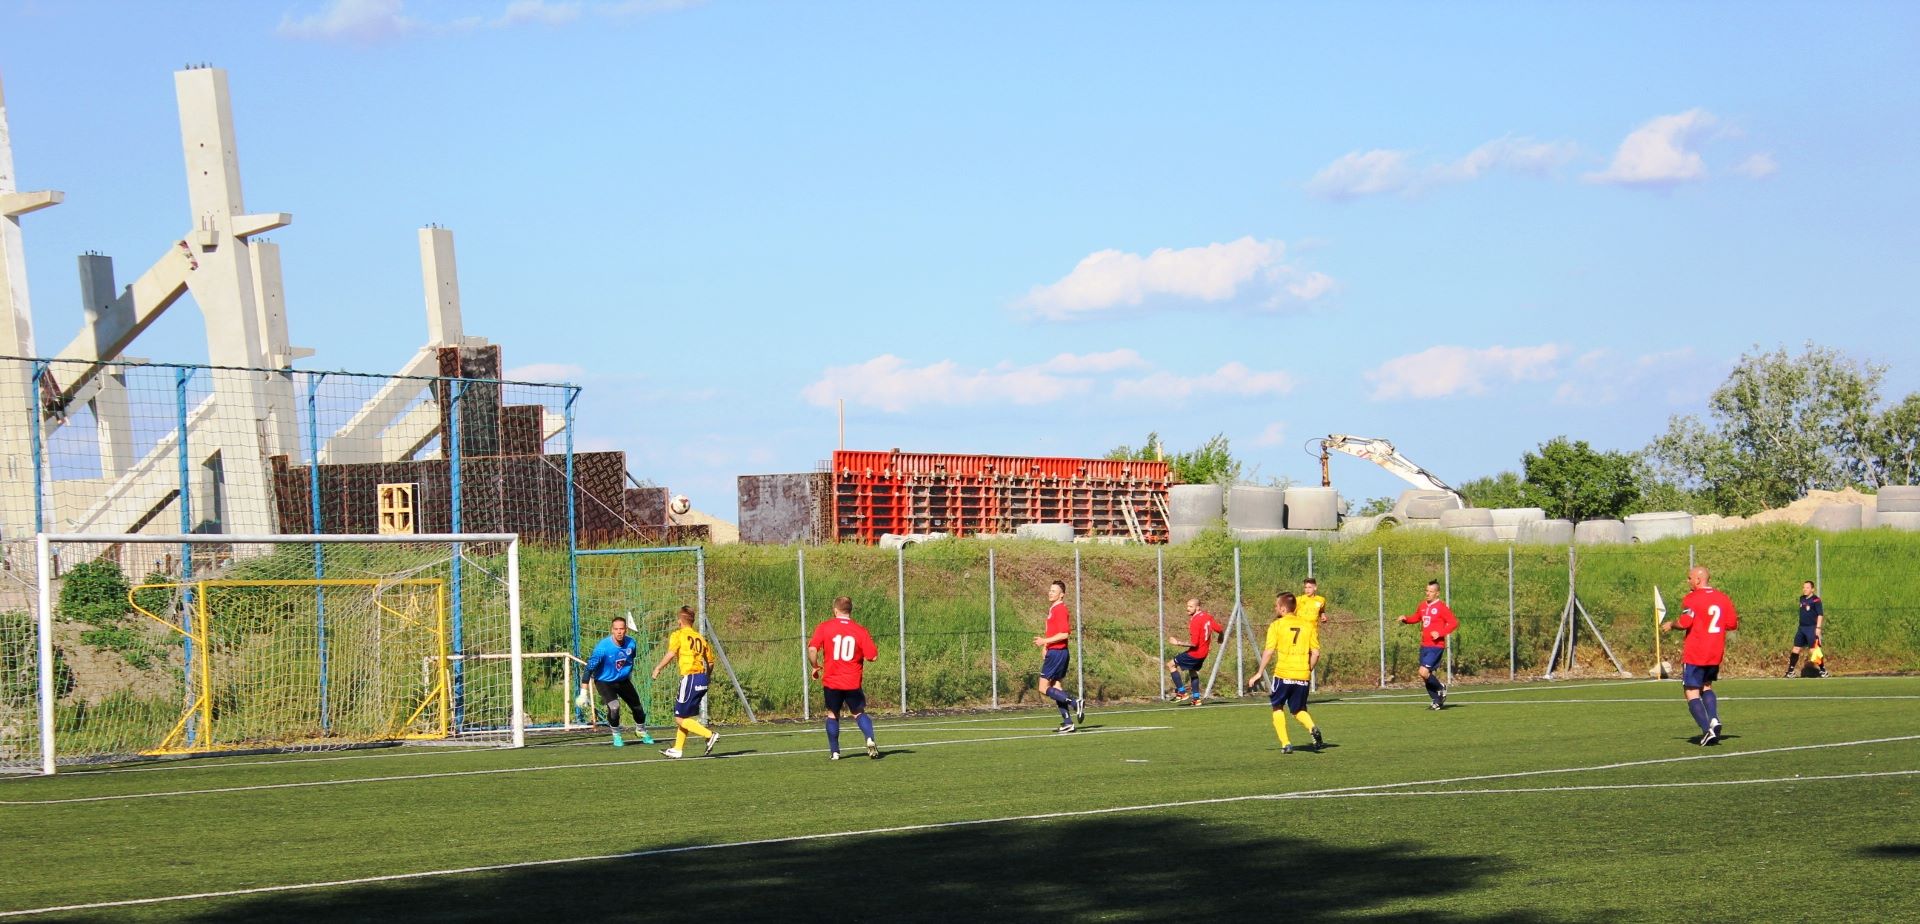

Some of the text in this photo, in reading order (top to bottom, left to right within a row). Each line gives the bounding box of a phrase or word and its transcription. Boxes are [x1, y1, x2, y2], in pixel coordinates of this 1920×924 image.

[1708, 605, 1721, 634] 2
[687, 635, 703, 654] 20
[1290, 627, 1301, 645] 7
[832, 634, 856, 662] 10
